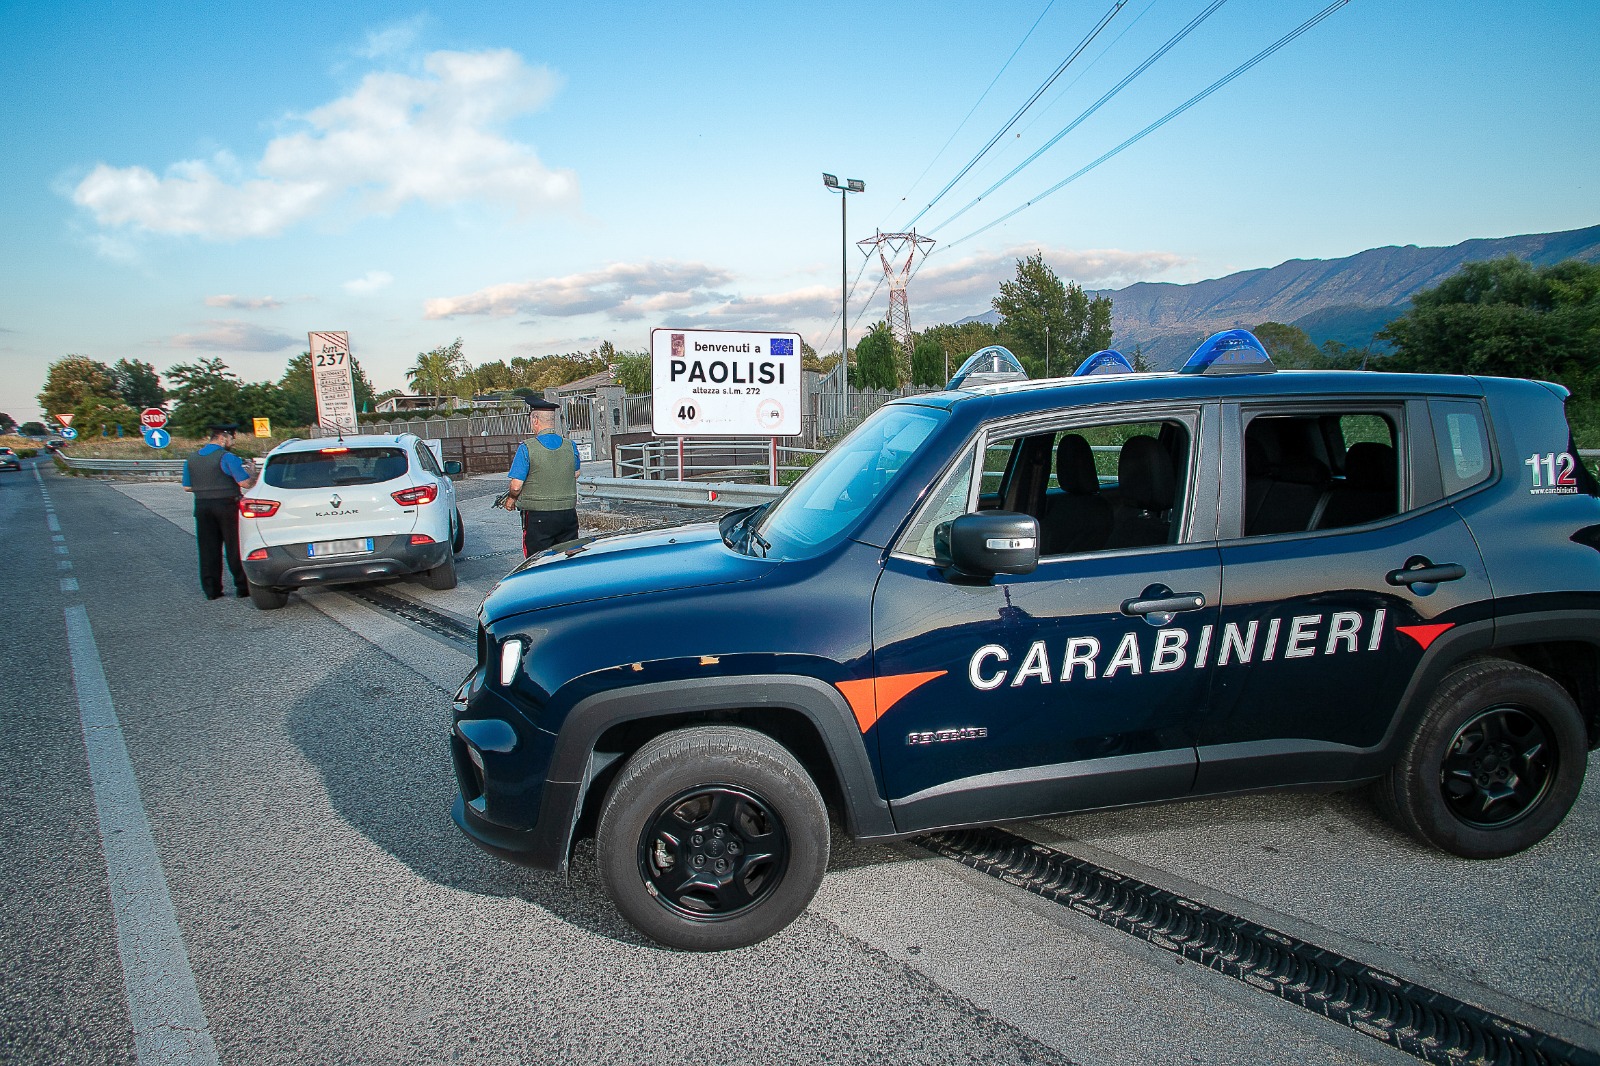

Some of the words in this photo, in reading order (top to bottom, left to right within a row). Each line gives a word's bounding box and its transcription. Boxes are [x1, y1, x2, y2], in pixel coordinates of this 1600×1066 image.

[322, 344, 338, 354] km
[694, 341, 750, 353] benvenuti
[754, 345, 761, 353] a
[316, 353, 345, 367] 237
[670, 359, 785, 385] PAOLISI
[692, 387, 720, 395] altezza
[722, 387, 743, 395] s.l.m.
[745, 387, 761, 395] 272
[143, 414, 166, 423] STOP
[677, 405, 696, 420] 40
[1524, 452, 1577, 487] 112
[315, 509, 359, 517] KADJAR
[968, 608, 1387, 691] CARABINIERI
[908, 727, 988, 745] RENEGADE
